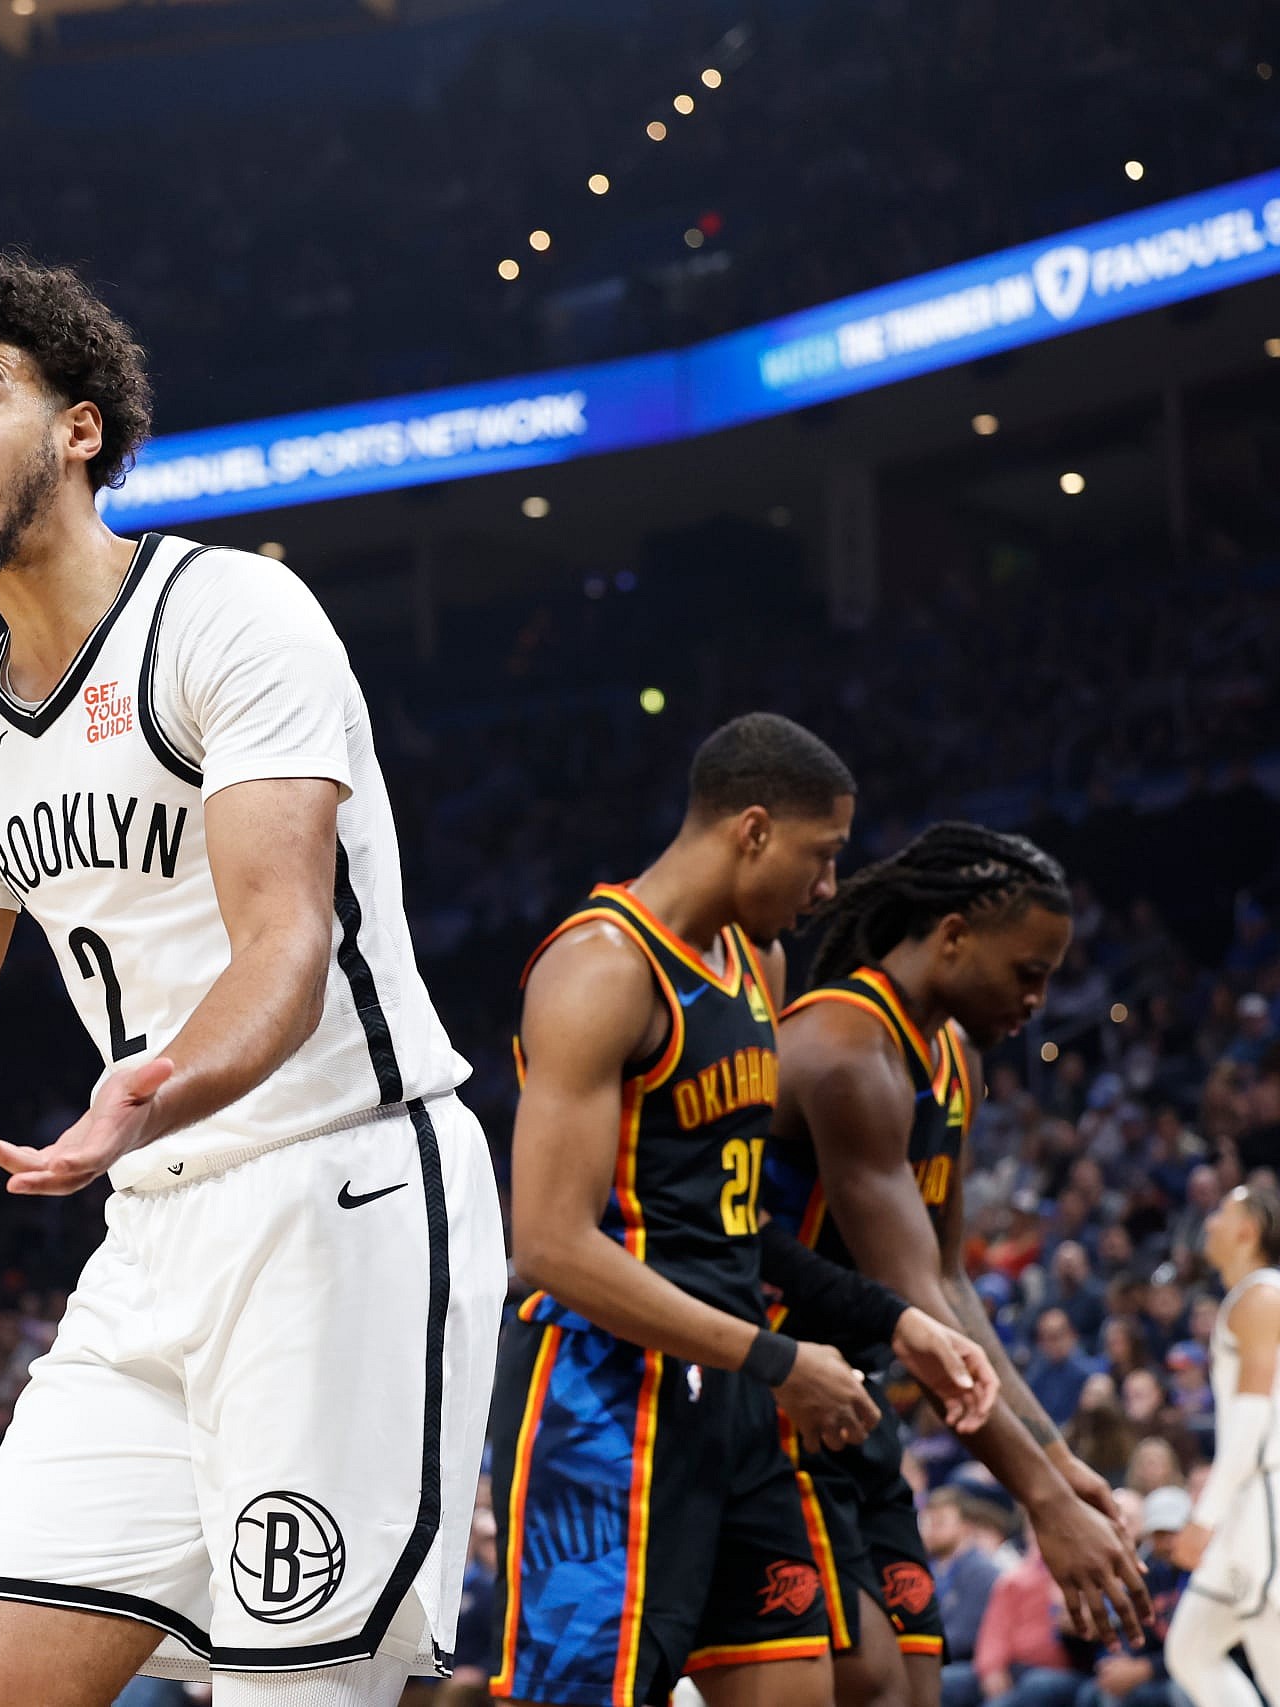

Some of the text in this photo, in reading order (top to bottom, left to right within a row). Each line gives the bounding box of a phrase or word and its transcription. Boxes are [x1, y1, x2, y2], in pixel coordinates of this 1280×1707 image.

[1090, 208, 1265, 296] FANDUEL
[268, 421, 410, 484] SPORTS
[407, 390, 588, 458] NETWORK
[83, 681, 118, 704] GET
[85, 695, 131, 723] YOUR
[87, 713, 132, 743] GUIDE
[68, 926, 147, 1062] 2
[673, 1046, 779, 1131] OKLAHO
[720, 1138, 765, 1236] 21
[262, 1512, 300, 1602] B
